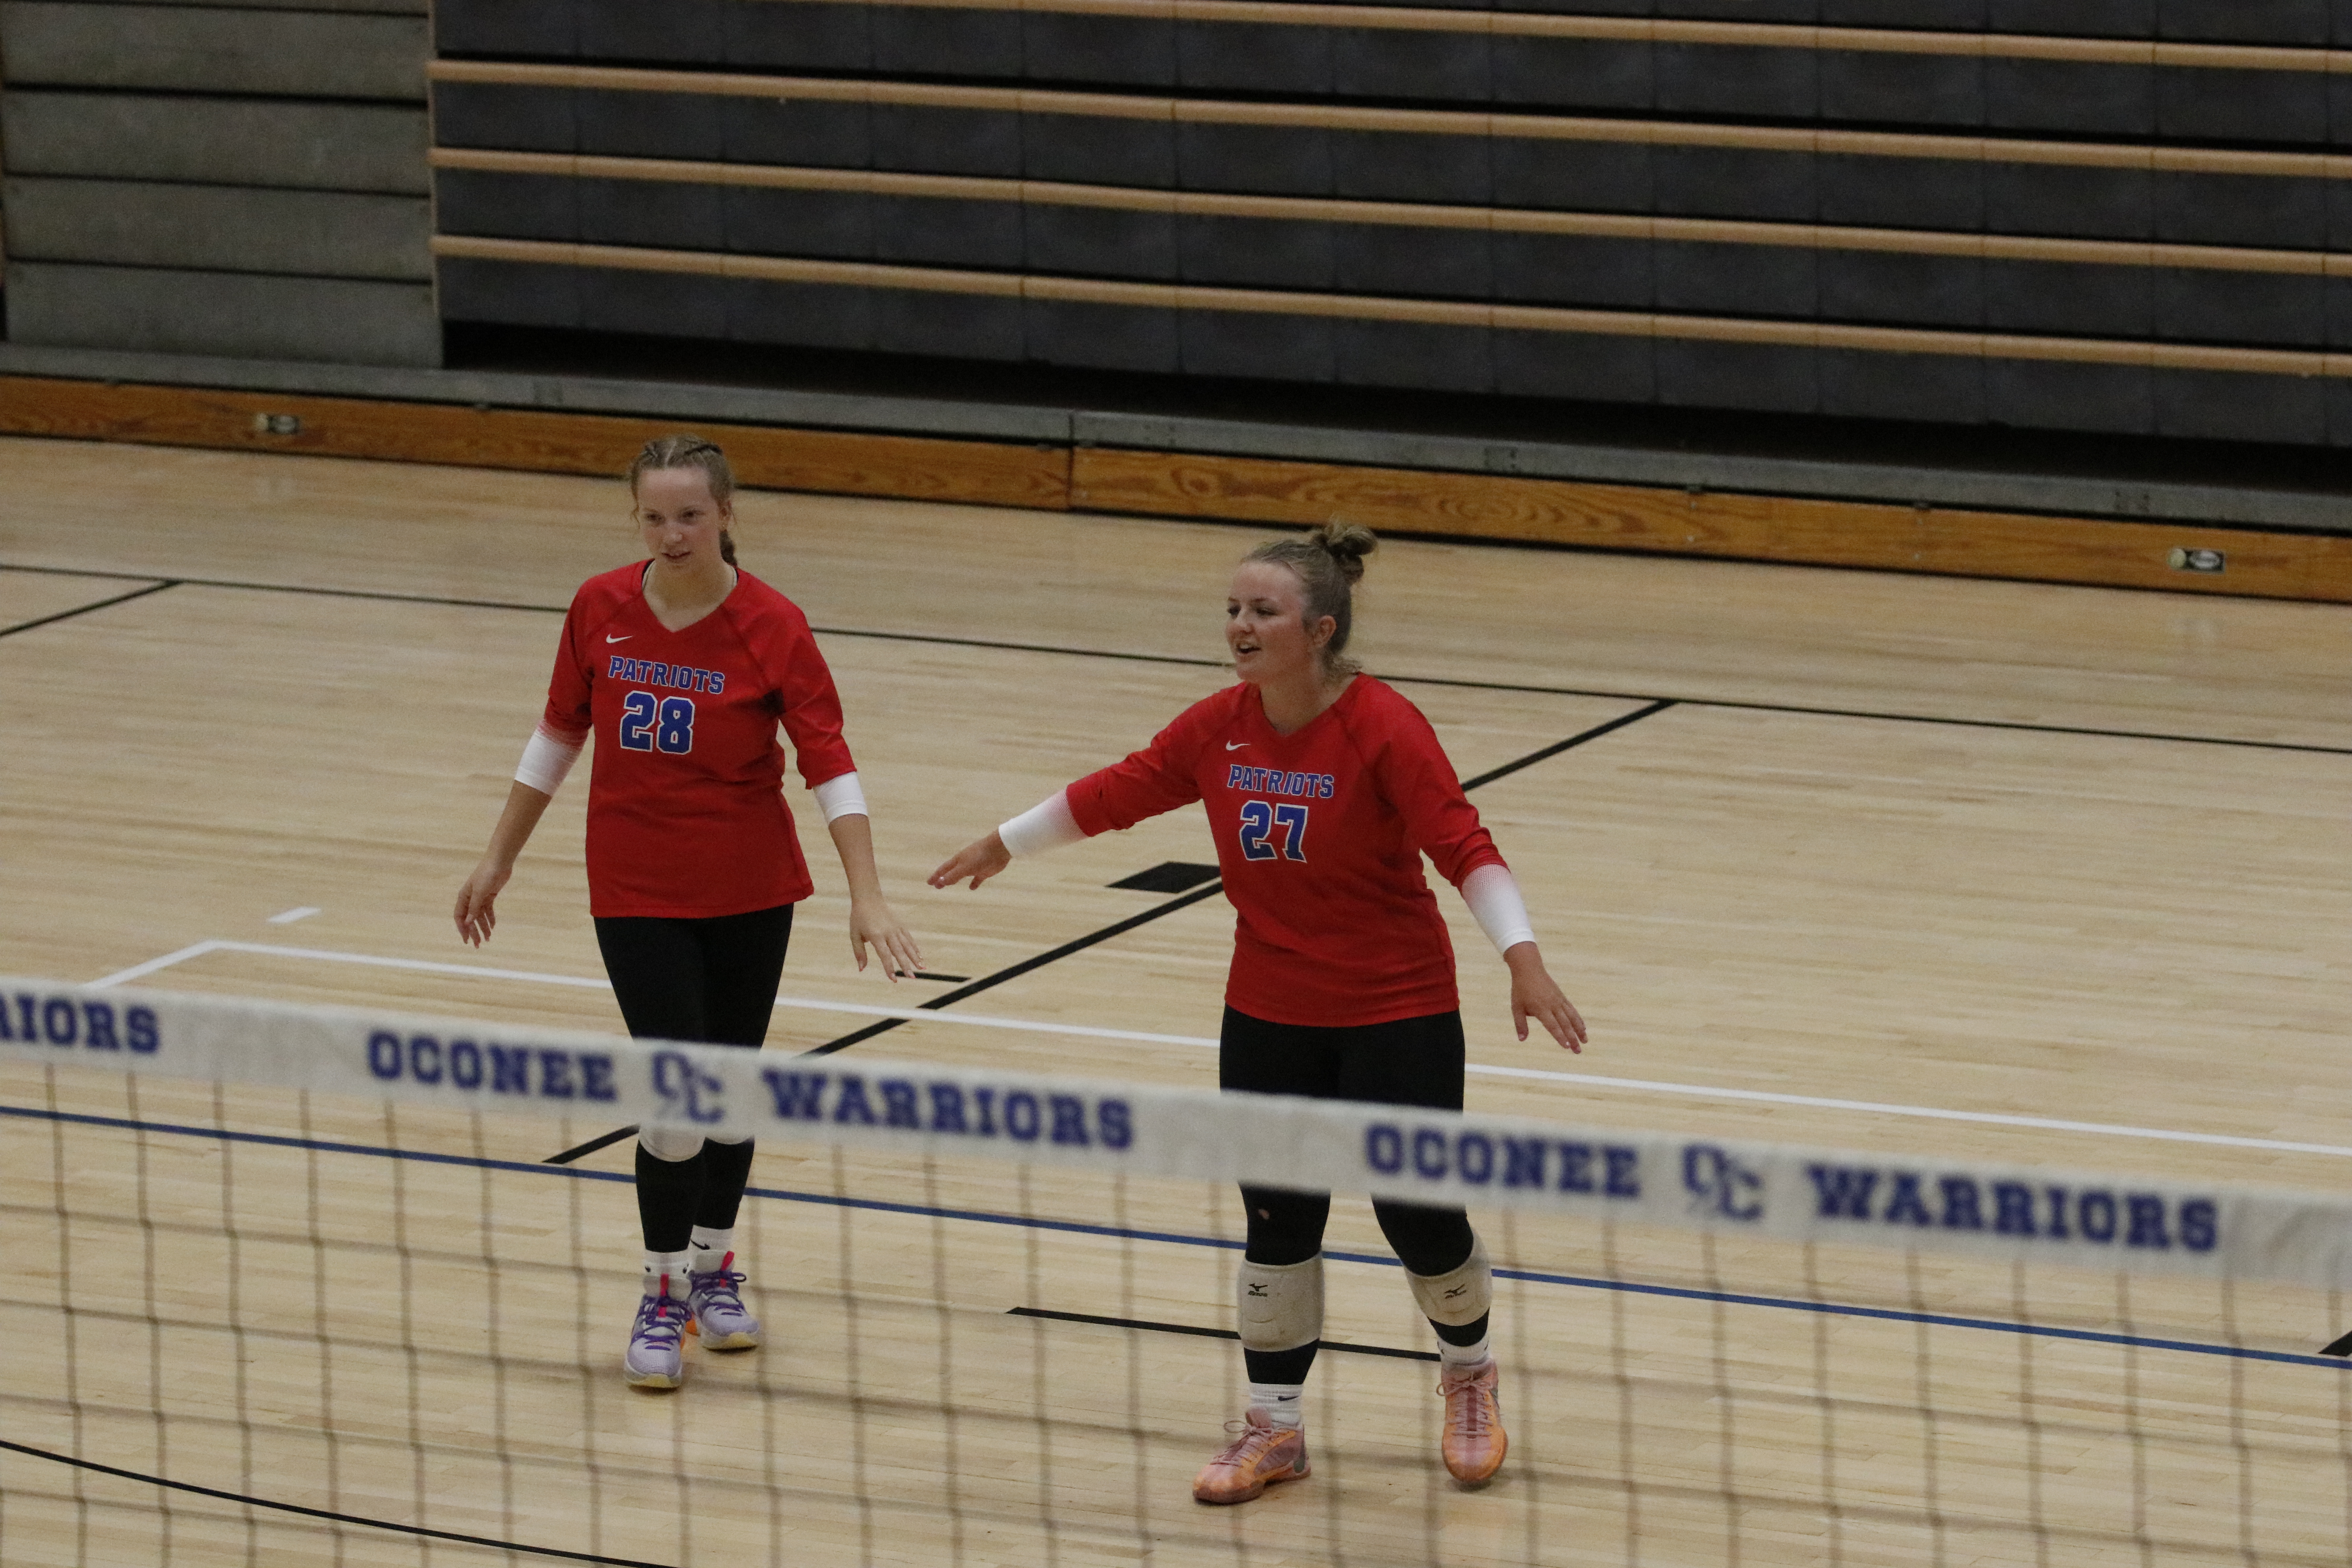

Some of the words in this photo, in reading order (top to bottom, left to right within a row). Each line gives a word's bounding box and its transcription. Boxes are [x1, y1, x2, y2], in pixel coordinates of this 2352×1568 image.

[608, 655, 725, 694] PATRIOTS
[620, 690, 695, 755] 28
[1227, 764, 1334, 799] PATRIOTS
[1239, 800, 1308, 863] 27
[367, 1028, 617, 1102] OCONEE
[762, 1065, 1134, 1151] WARRIORS
[1365, 1122, 1640, 1200] OCONEE
[1806, 1163, 2220, 1254] WARRIORS
